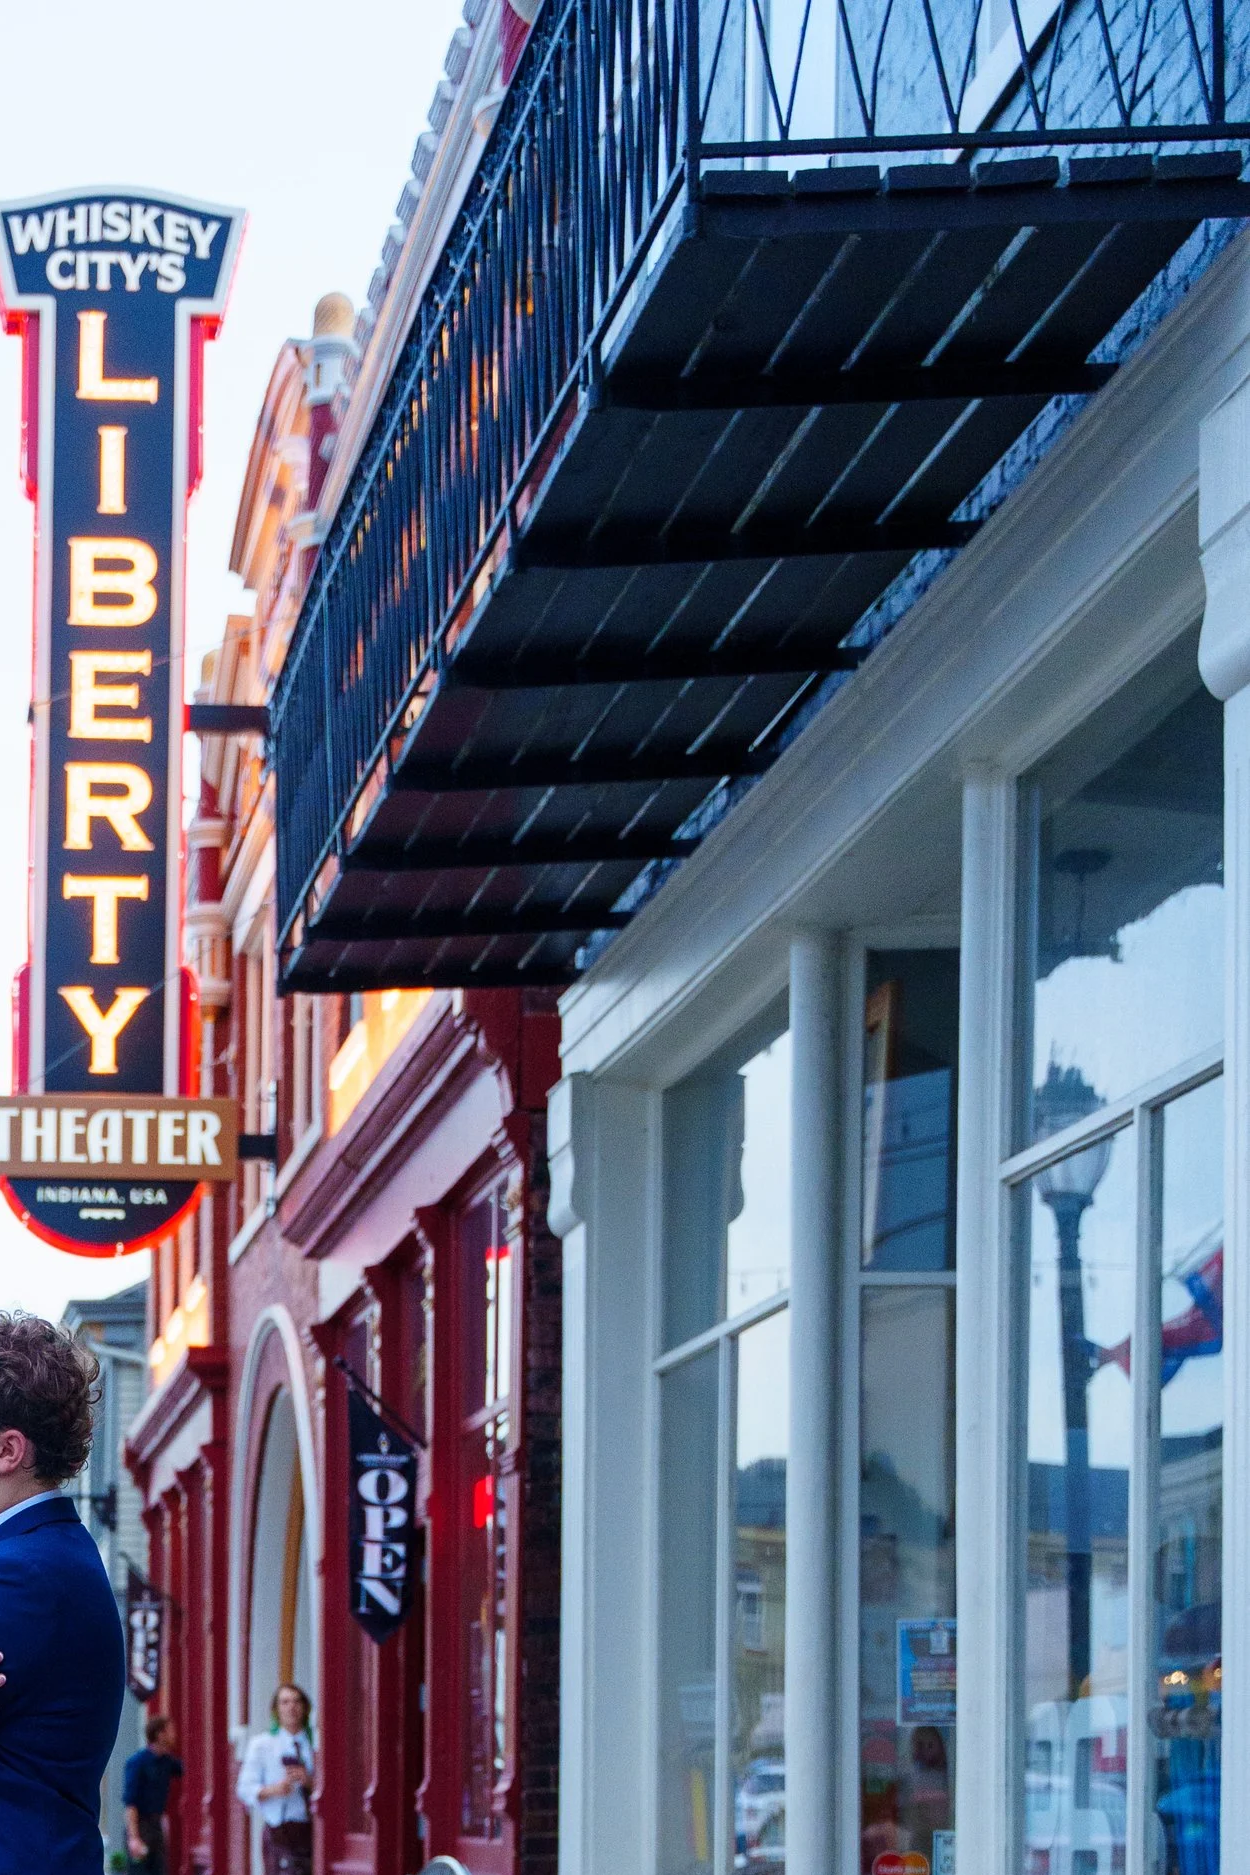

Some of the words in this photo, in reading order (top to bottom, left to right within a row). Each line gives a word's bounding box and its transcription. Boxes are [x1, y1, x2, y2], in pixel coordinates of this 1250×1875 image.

[8, 202, 220, 258] WHISKEY
[46, 250, 186, 293] CITY'S
[58, 310, 158, 1074] LIBERTY
[130, 1187, 168, 1205] USA
[356, 1467, 409, 1616] OPEN
